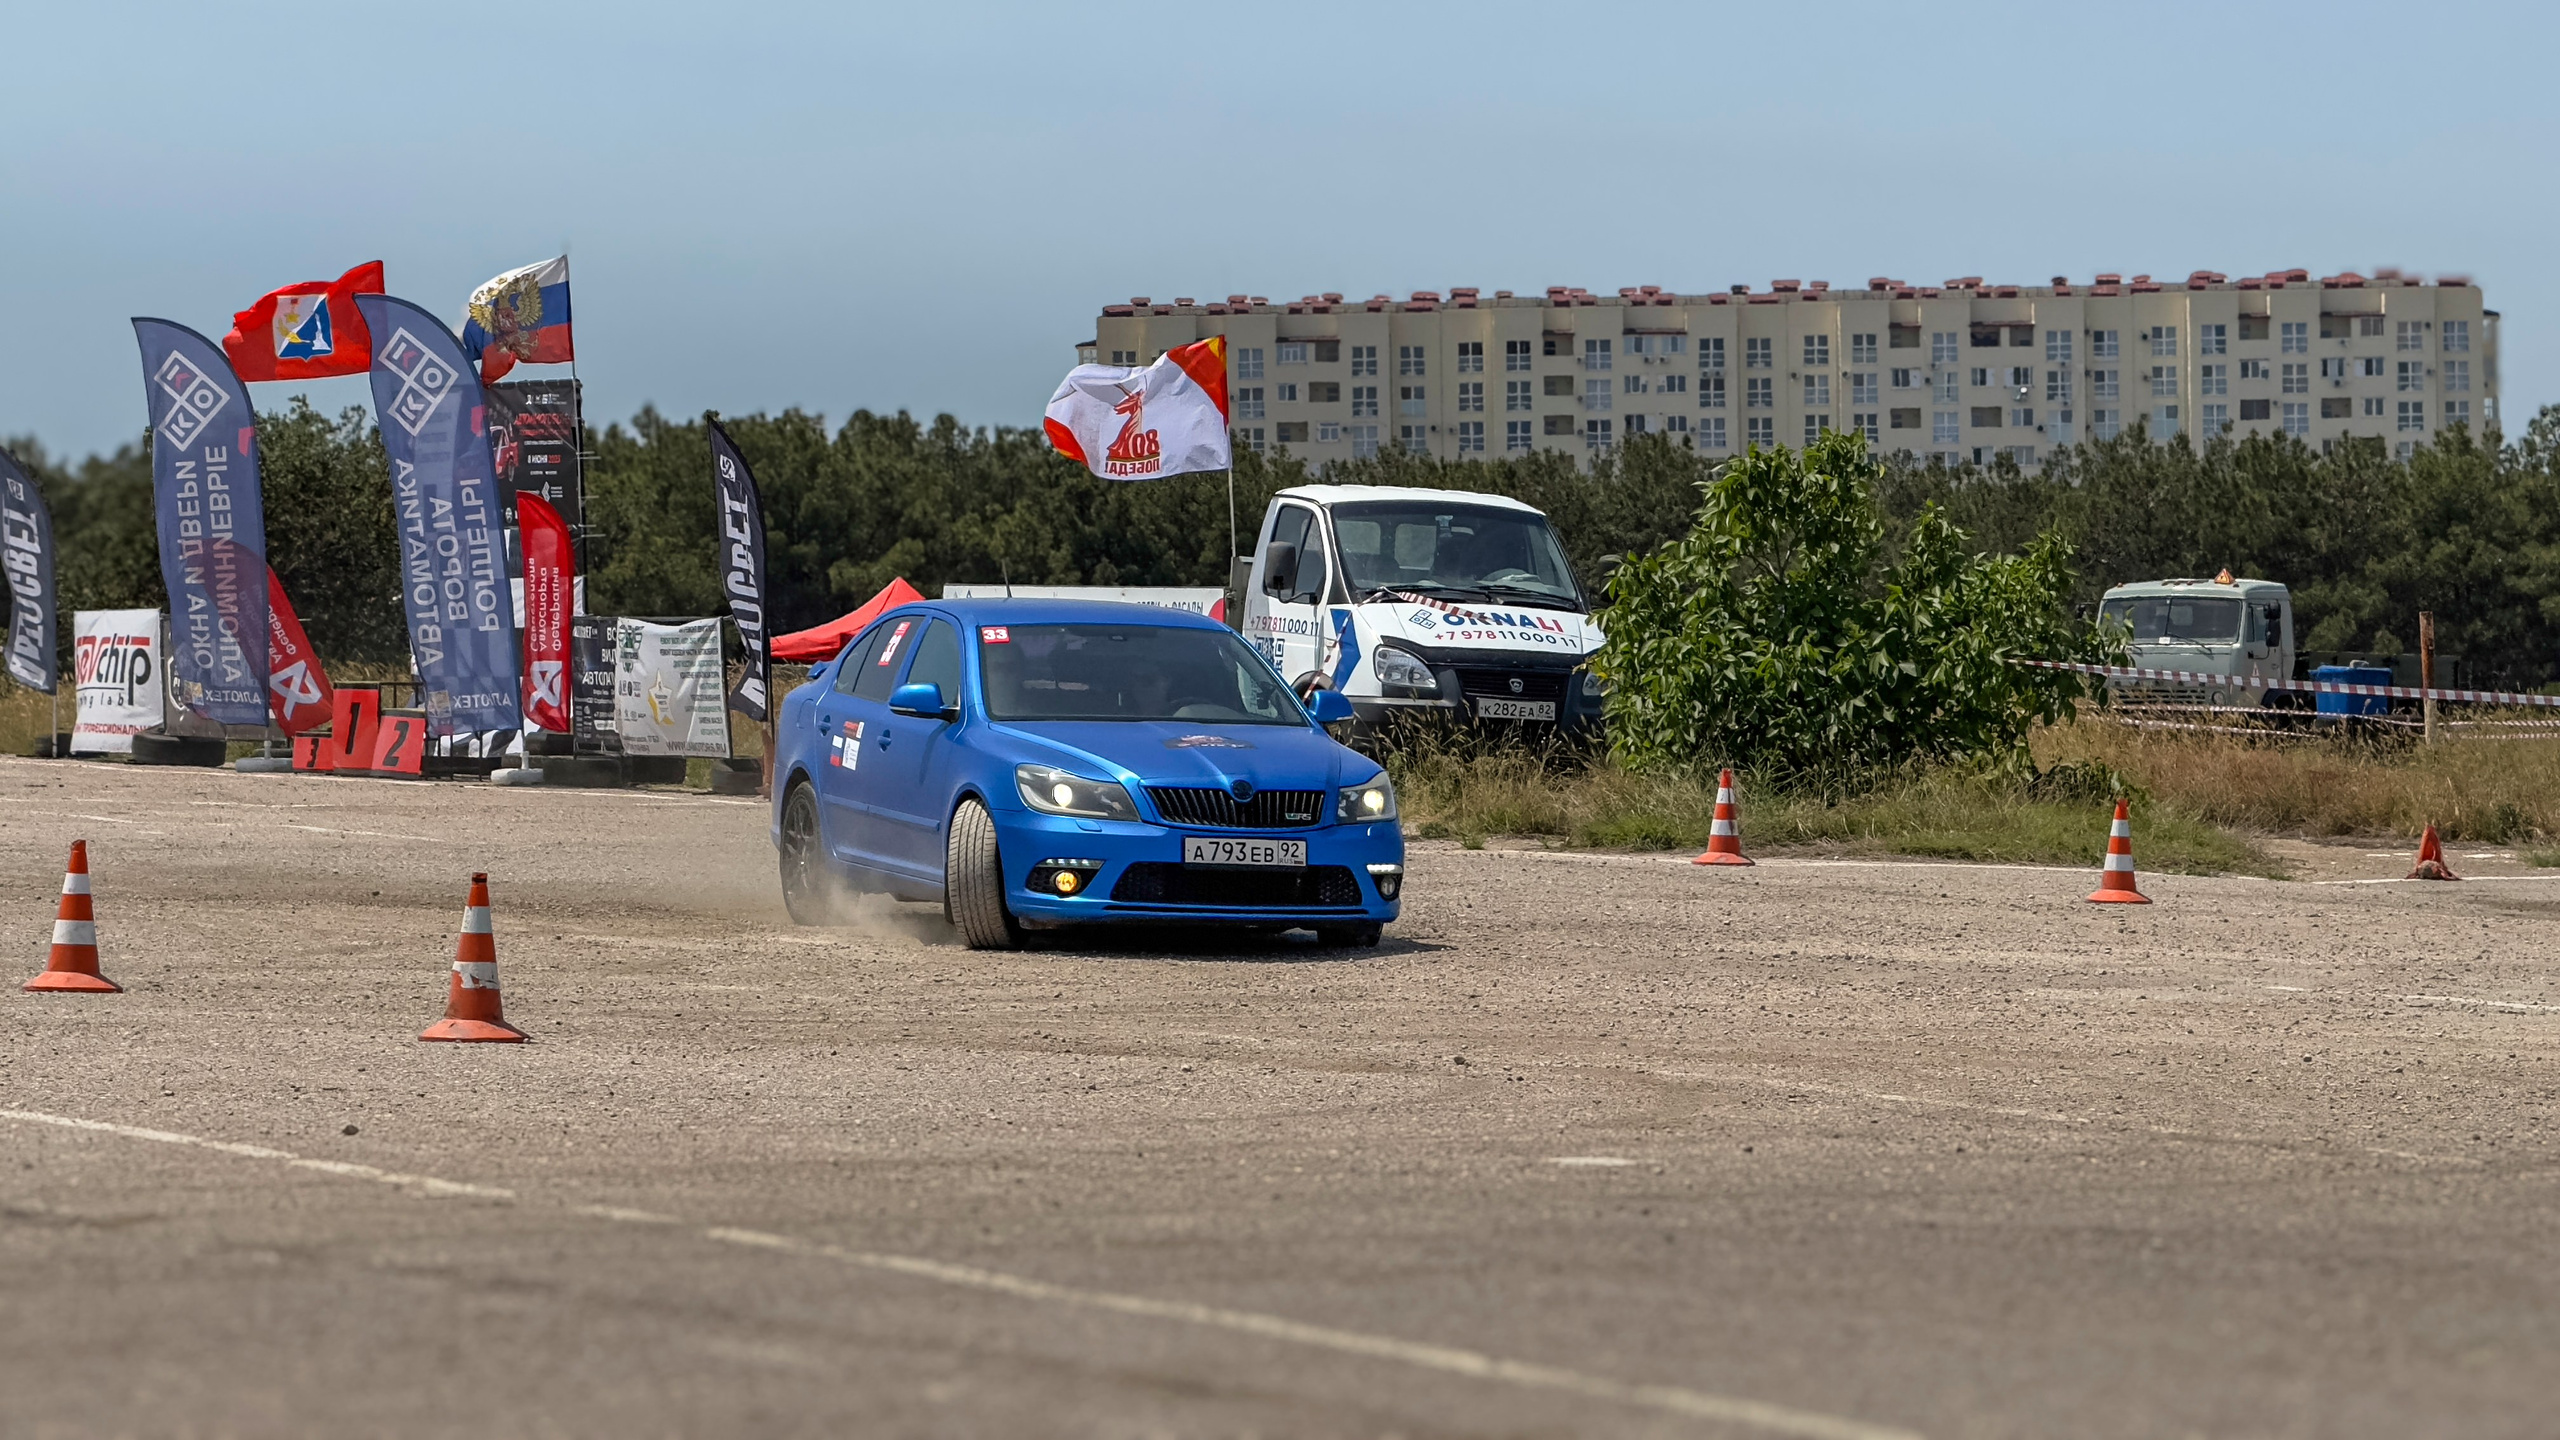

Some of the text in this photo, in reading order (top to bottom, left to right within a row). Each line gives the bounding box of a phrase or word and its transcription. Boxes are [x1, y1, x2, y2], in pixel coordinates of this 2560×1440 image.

[983, 628, 1008, 640] 33
[83, 722, 152, 736] ПРОФЕССИОНАЛЬН
[345, 702, 361, 755] 1
[306, 738, 320, 768] 3
[382, 720, 410, 767] 2
[1193, 841, 1300, 862] A793EB 92
